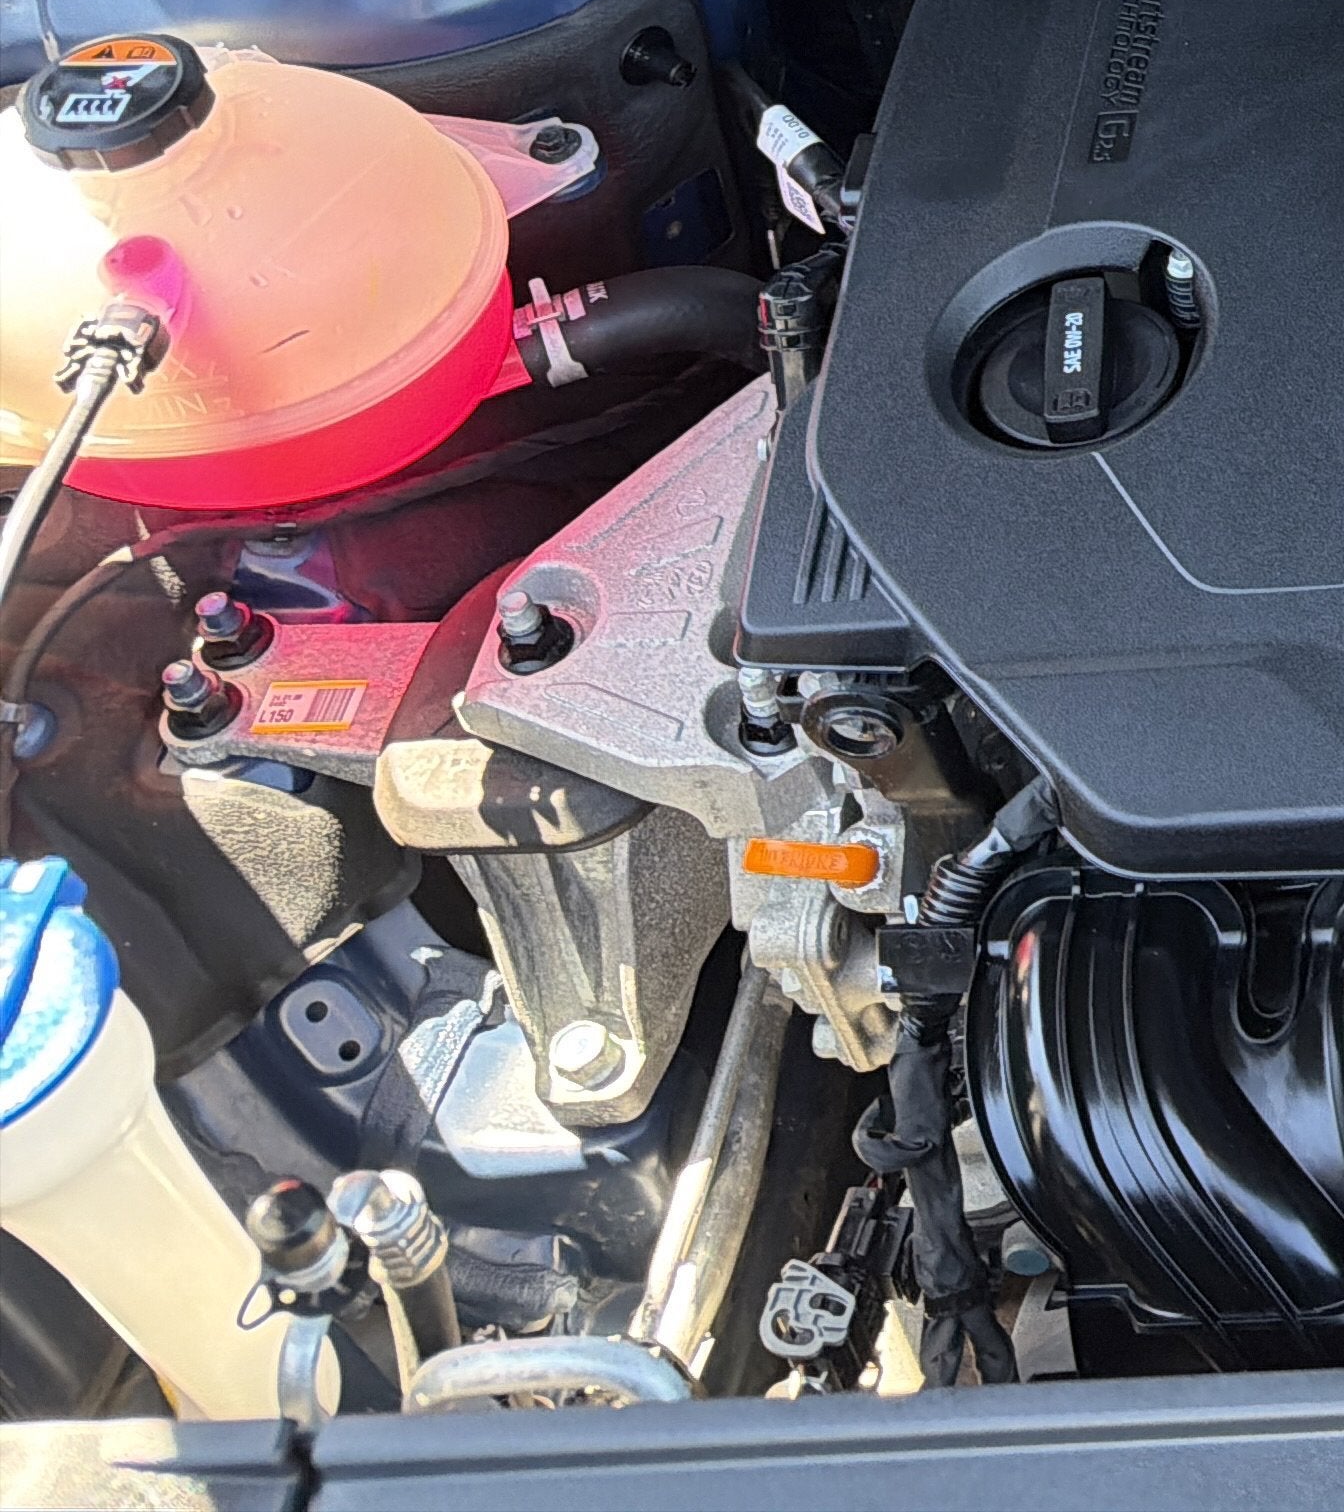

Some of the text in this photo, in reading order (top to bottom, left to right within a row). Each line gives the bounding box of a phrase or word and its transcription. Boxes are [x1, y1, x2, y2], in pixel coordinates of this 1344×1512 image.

[1062, 312, 1084, 374] SAE 0W-20
[258, 708, 295, 724] L150
